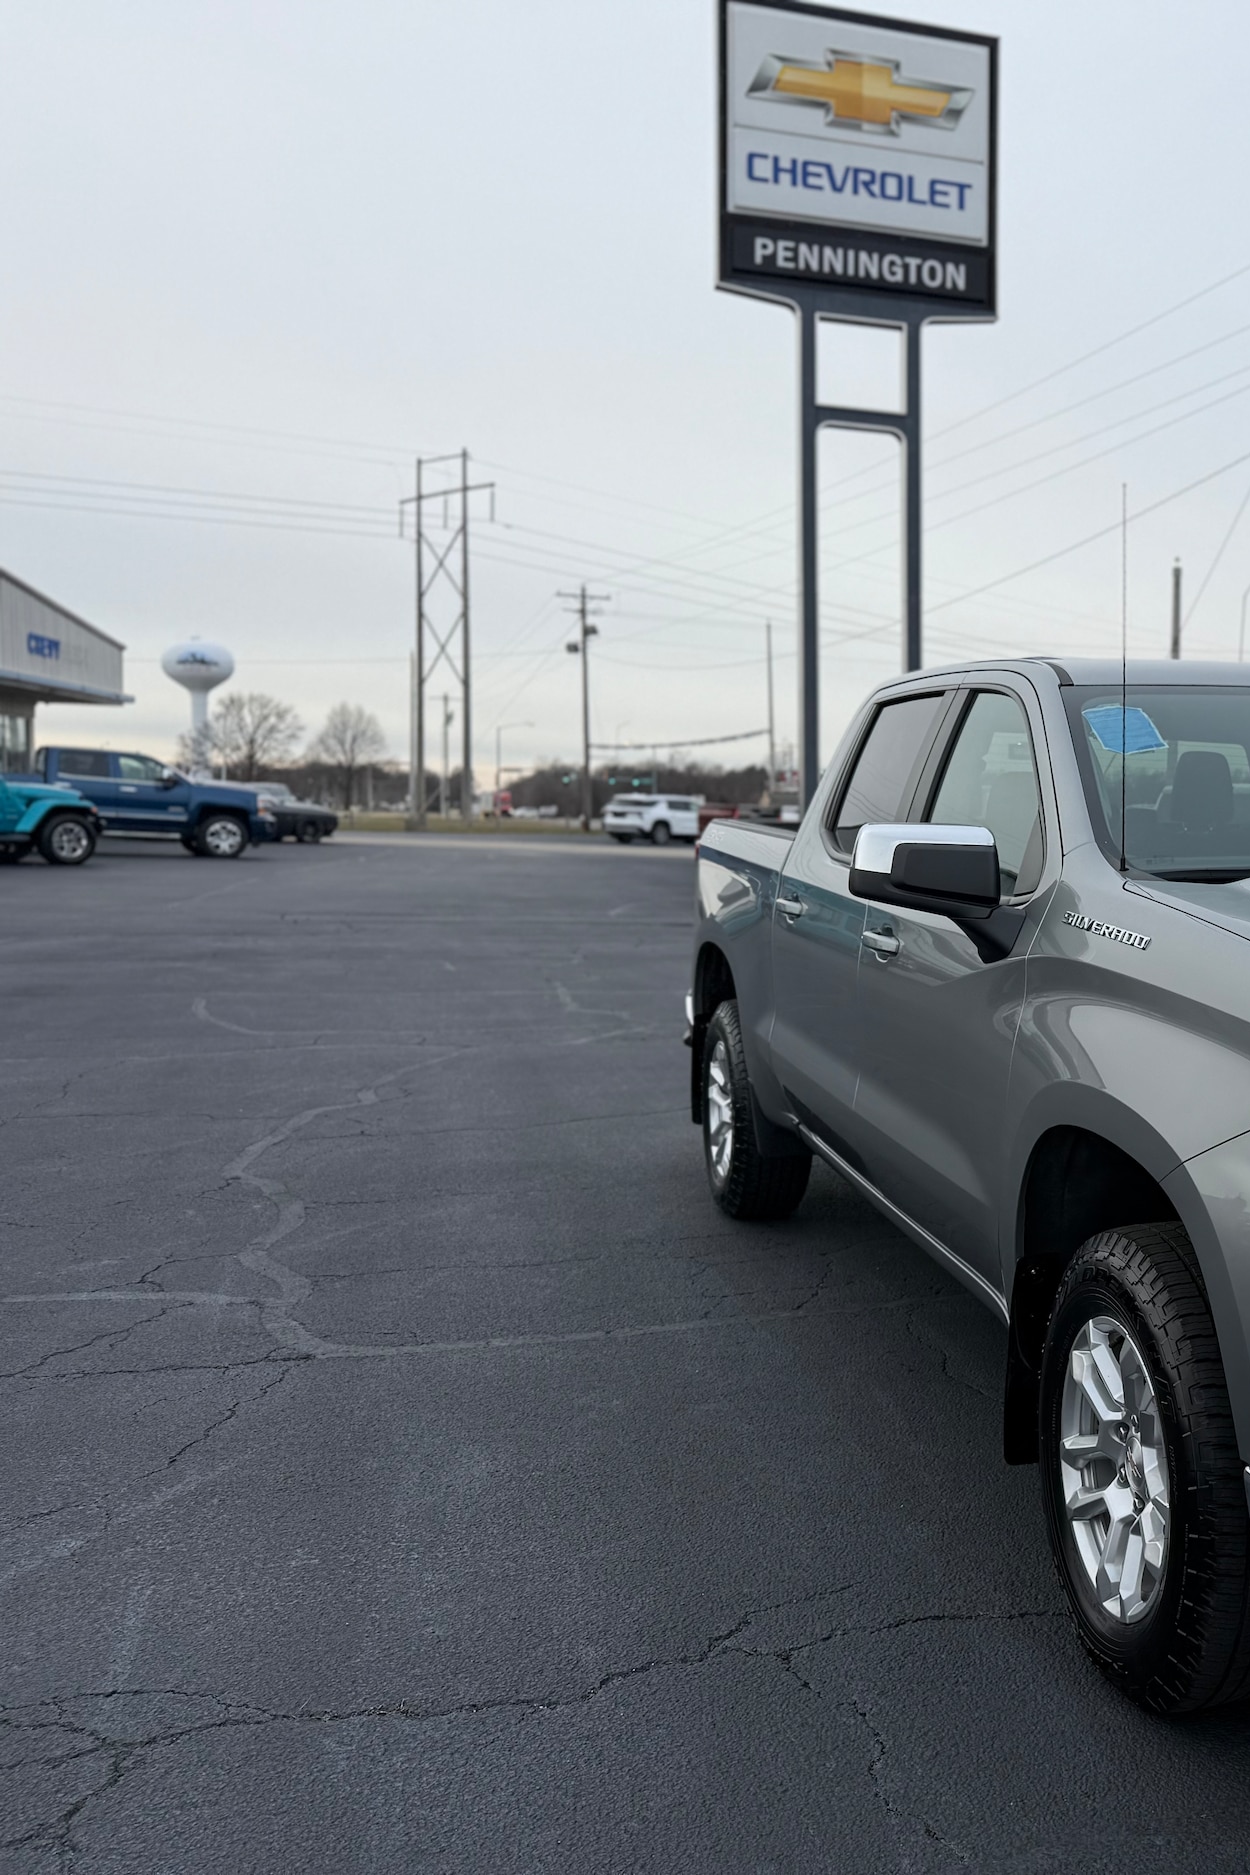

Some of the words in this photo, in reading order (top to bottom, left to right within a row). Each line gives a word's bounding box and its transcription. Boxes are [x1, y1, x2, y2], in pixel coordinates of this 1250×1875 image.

[746, 151, 973, 212] CHEVROLET
[753, 236, 967, 291] PENNINGTON
[1061, 910, 1151, 950] SILVERADO
